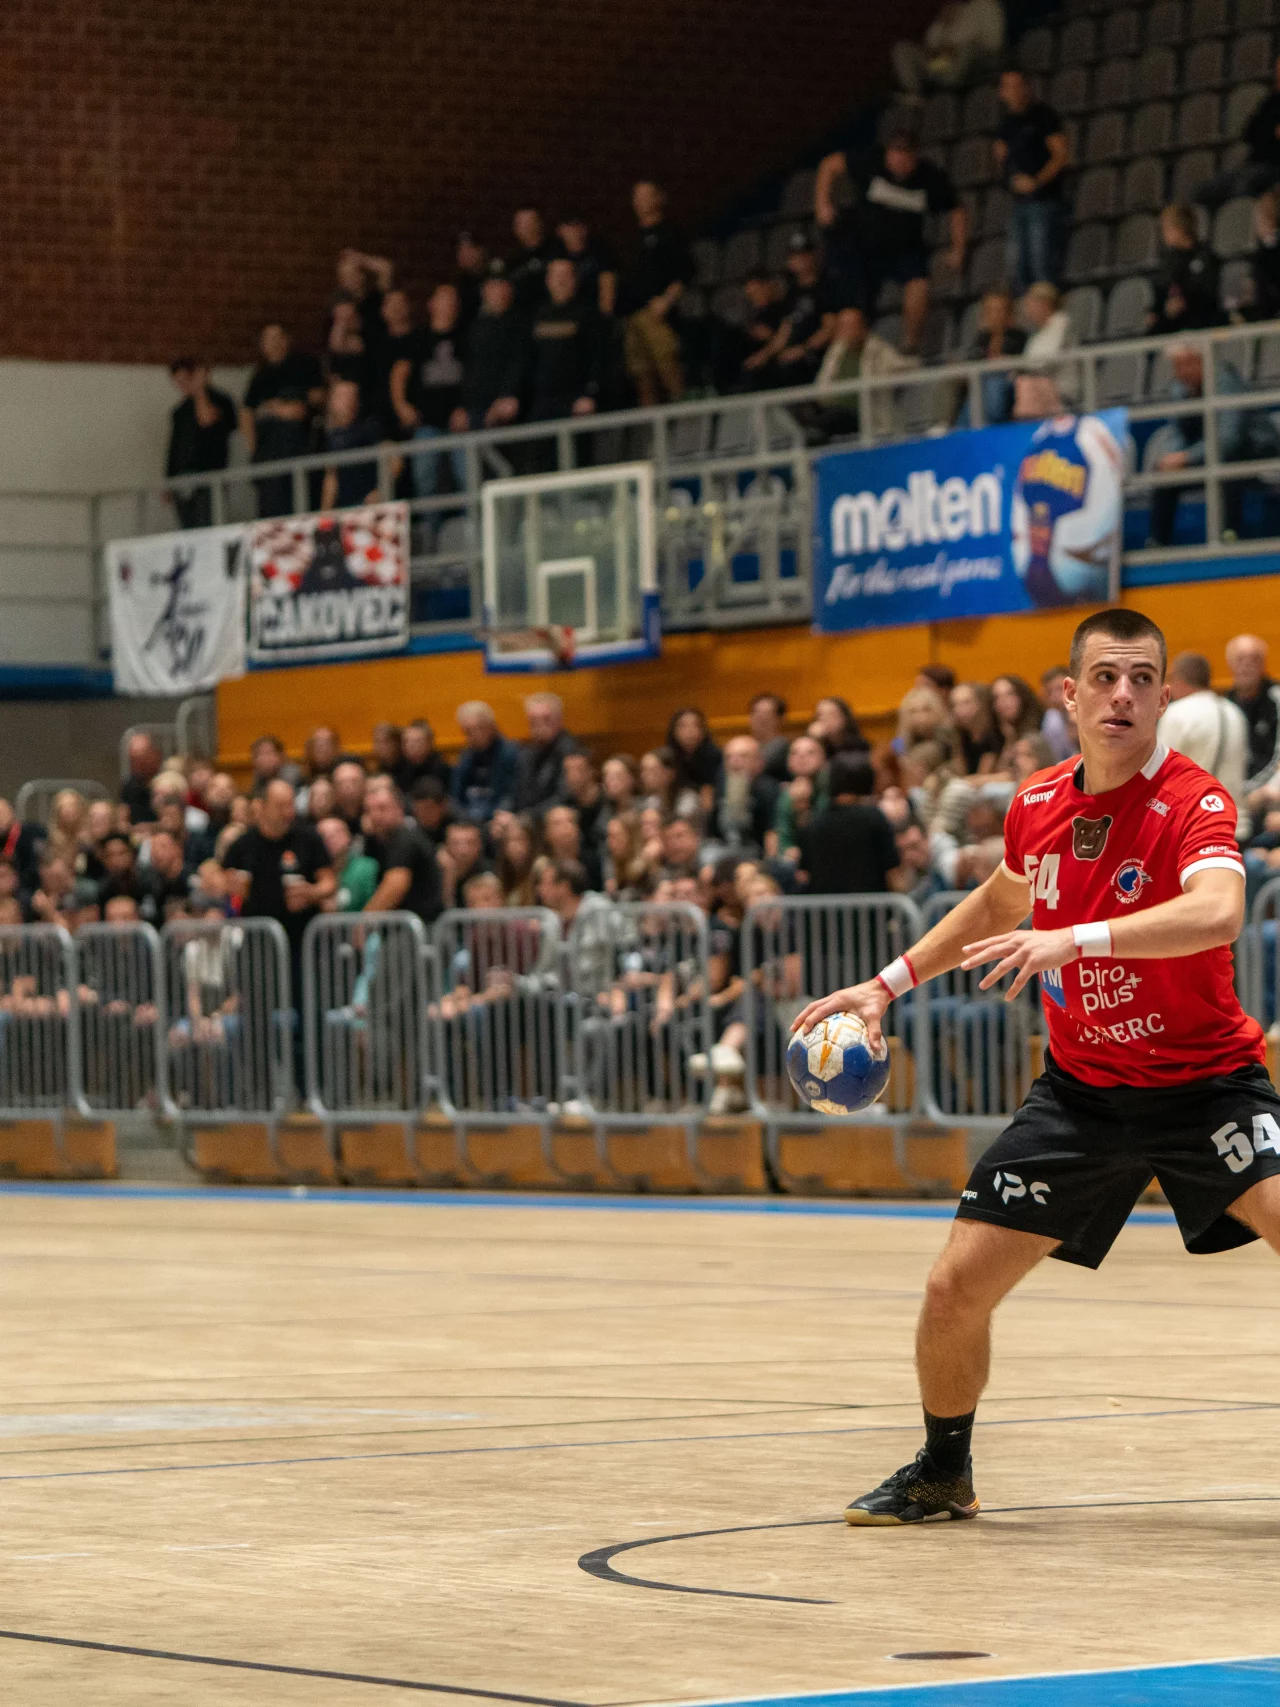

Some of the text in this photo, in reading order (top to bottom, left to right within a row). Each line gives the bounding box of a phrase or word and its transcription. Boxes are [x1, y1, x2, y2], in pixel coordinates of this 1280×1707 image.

[831, 469, 1003, 558] molten
[1024, 853, 1061, 910] 54
[1078, 961, 1125, 988] biro
[1081, 984, 1135, 1016] plus
